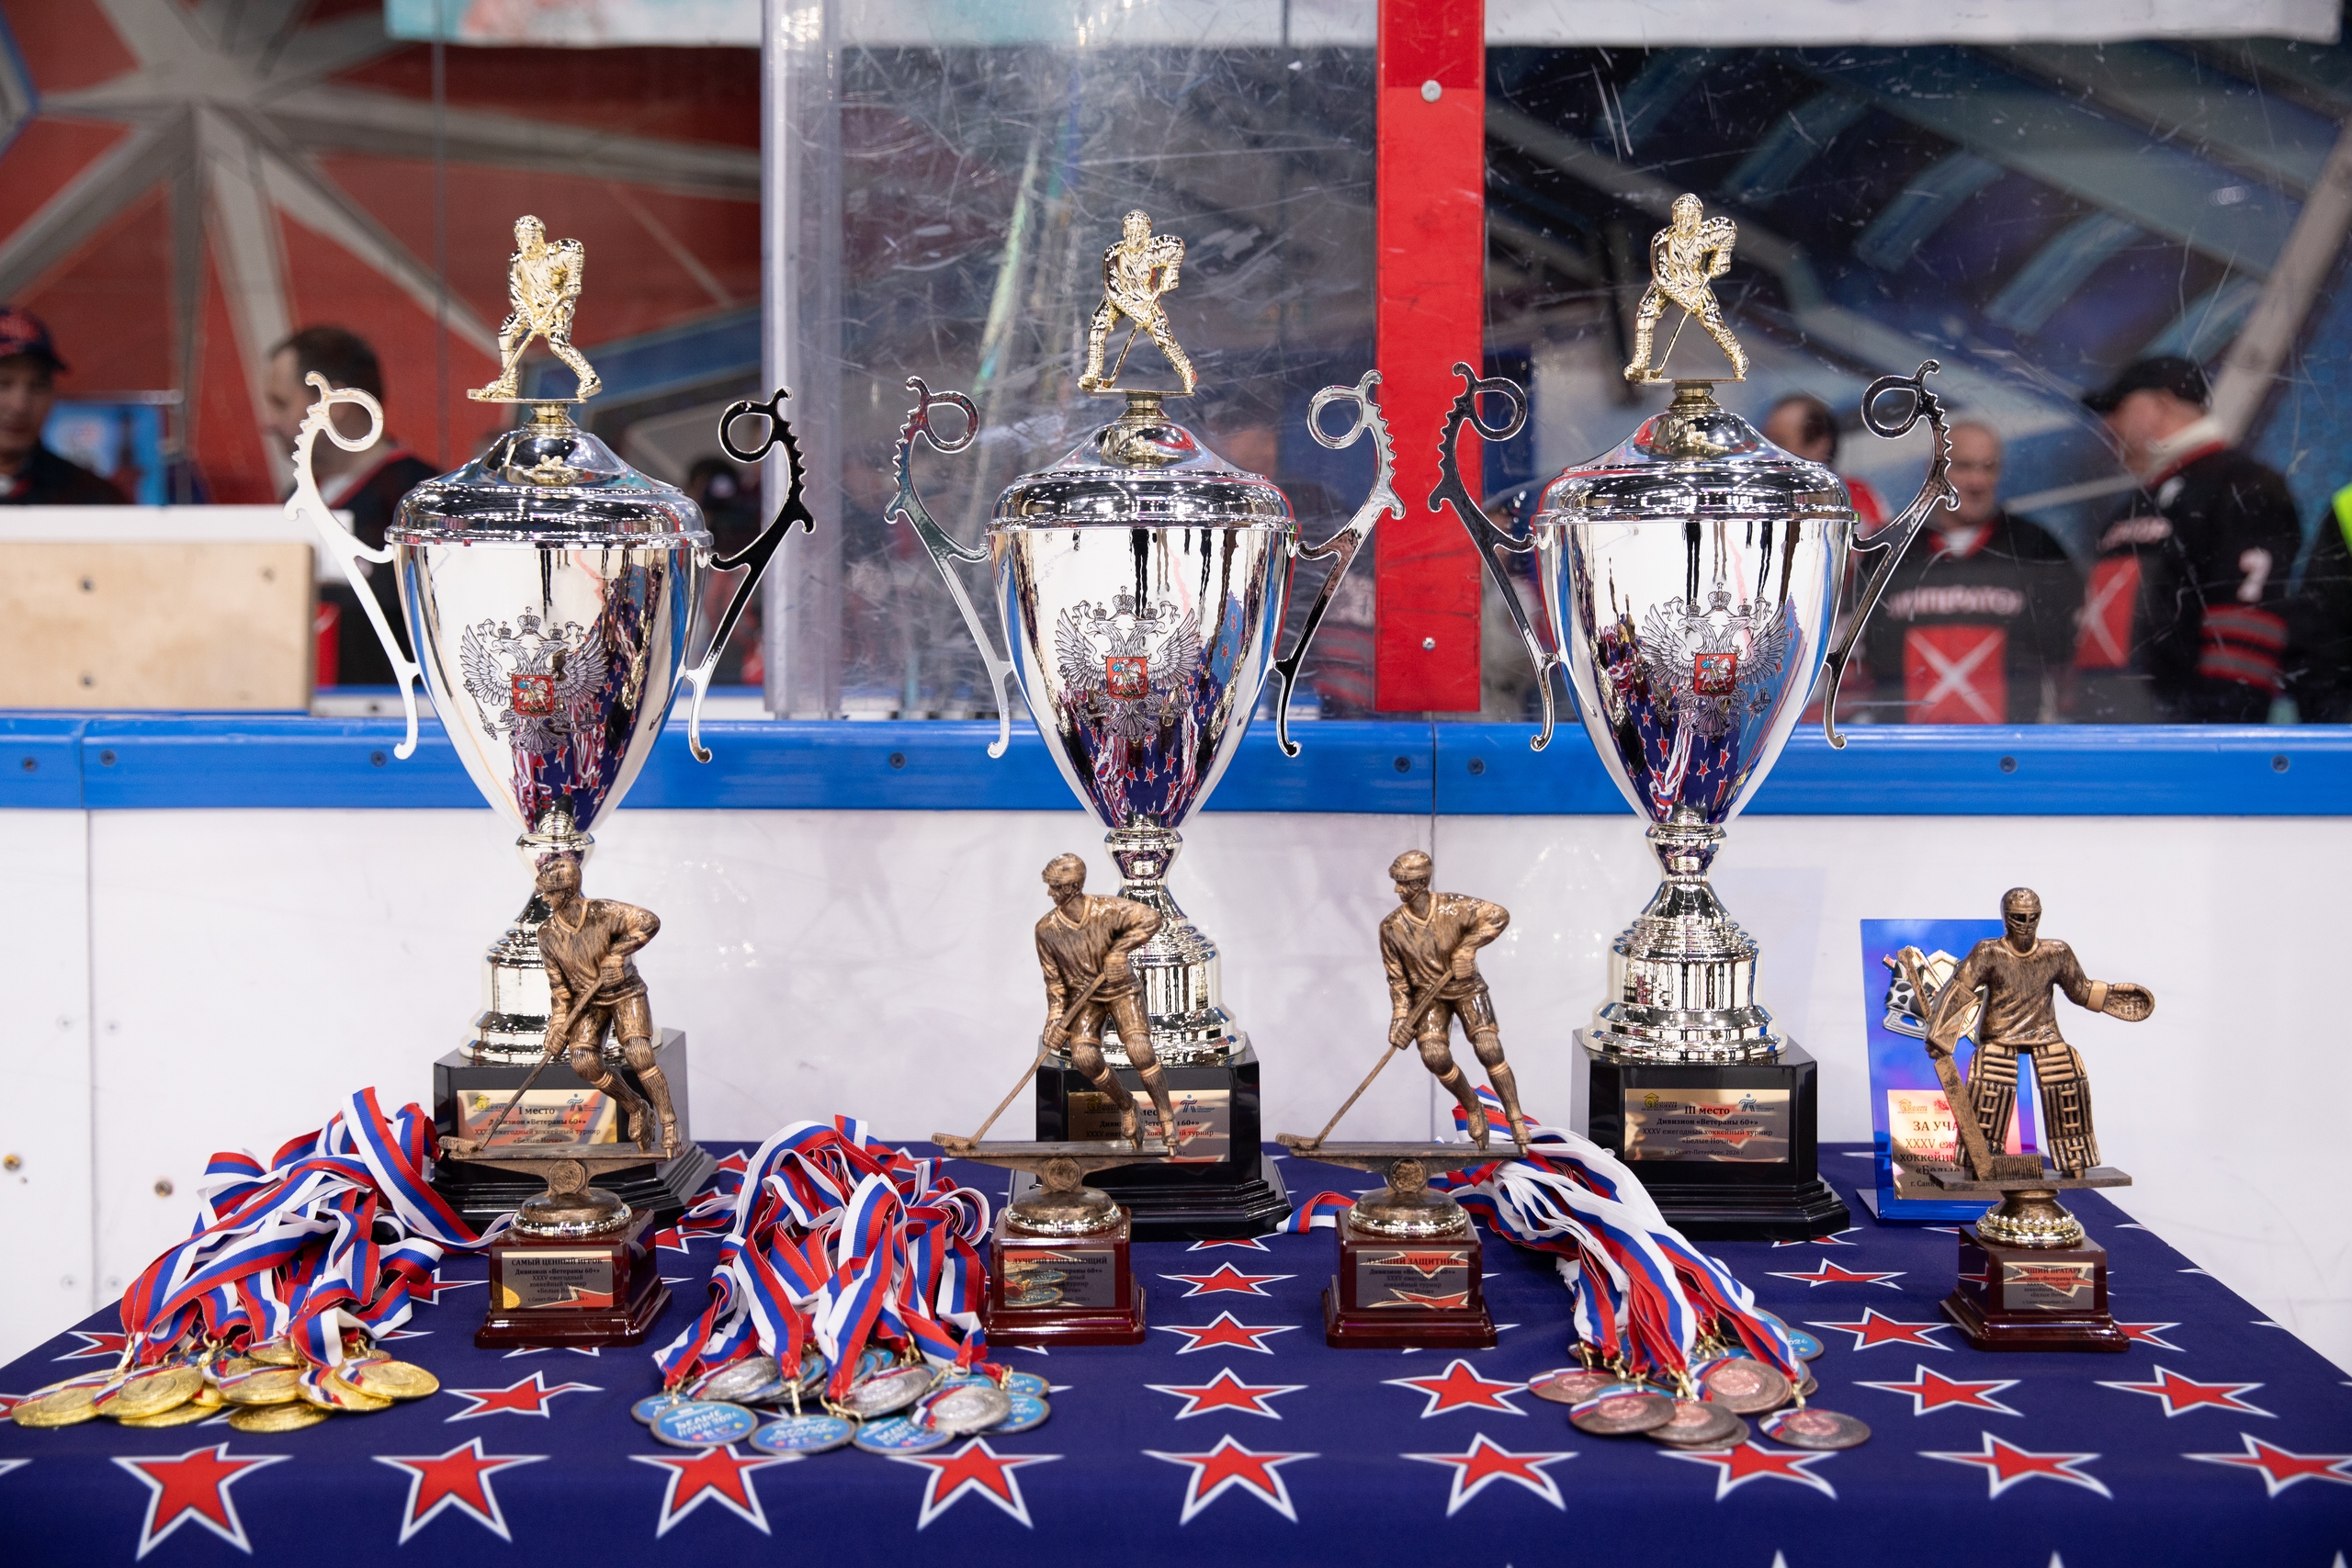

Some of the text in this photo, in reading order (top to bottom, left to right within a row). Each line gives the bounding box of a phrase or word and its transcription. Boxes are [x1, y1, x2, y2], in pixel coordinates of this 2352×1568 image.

[1684, 1106, 1698, 1114] III
[1657, 1118, 1695, 1126] Дивизион
[1697, 1118, 1738, 1126] «Ветераны
[1913, 1121, 1930, 1131] ЗА
[1747, 1129, 1773, 1137] турнир
[1905, 1138, 1936, 1149] XXXV
[512, 1258, 540, 1266] САМЫЙ
[542, 1258, 576, 1267] ЦЕННЫЙ
[1408, 1258, 1460, 1266] ЗАЩИТНИК
